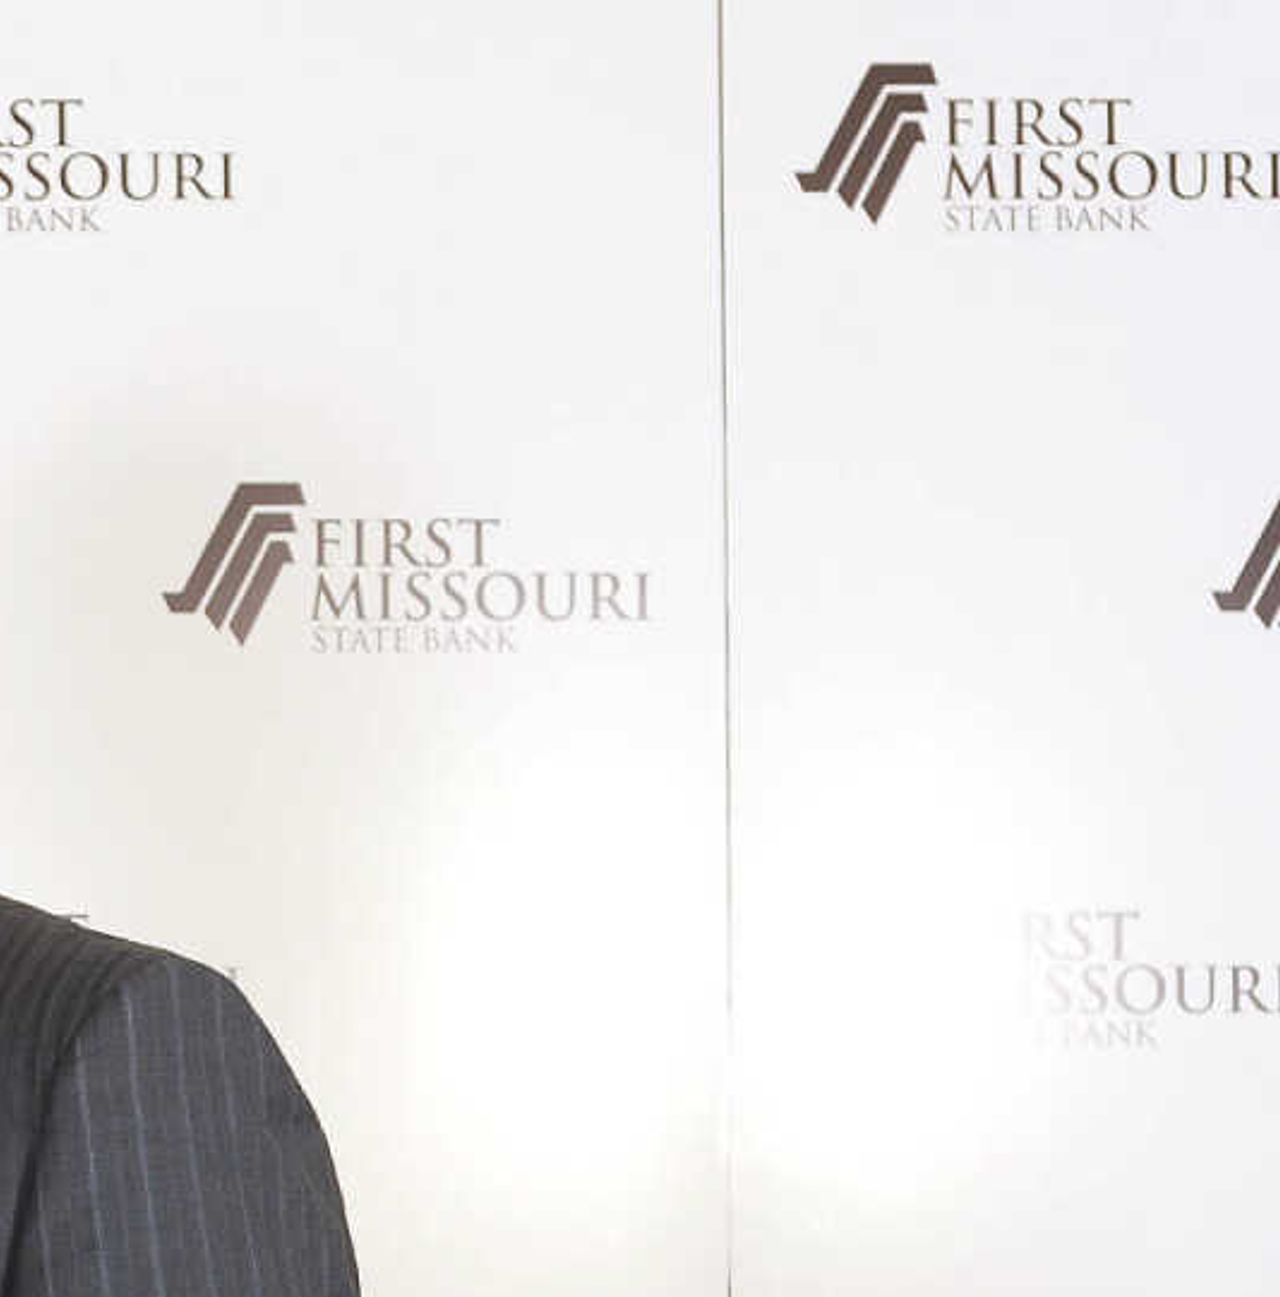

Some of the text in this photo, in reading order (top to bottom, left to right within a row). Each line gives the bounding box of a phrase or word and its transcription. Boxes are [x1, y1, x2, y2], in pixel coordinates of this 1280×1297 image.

[946, 97, 1134, 149] FIRST
[943, 150, 1280, 202] MISSOURI
[7, 206, 103, 233] BANK
[944, 206, 1152, 233] STATE BANK
[312, 517, 500, 569] FIRST
[309, 570, 650, 622] MISSOURI
[310, 626, 518, 653] STATE BANK
